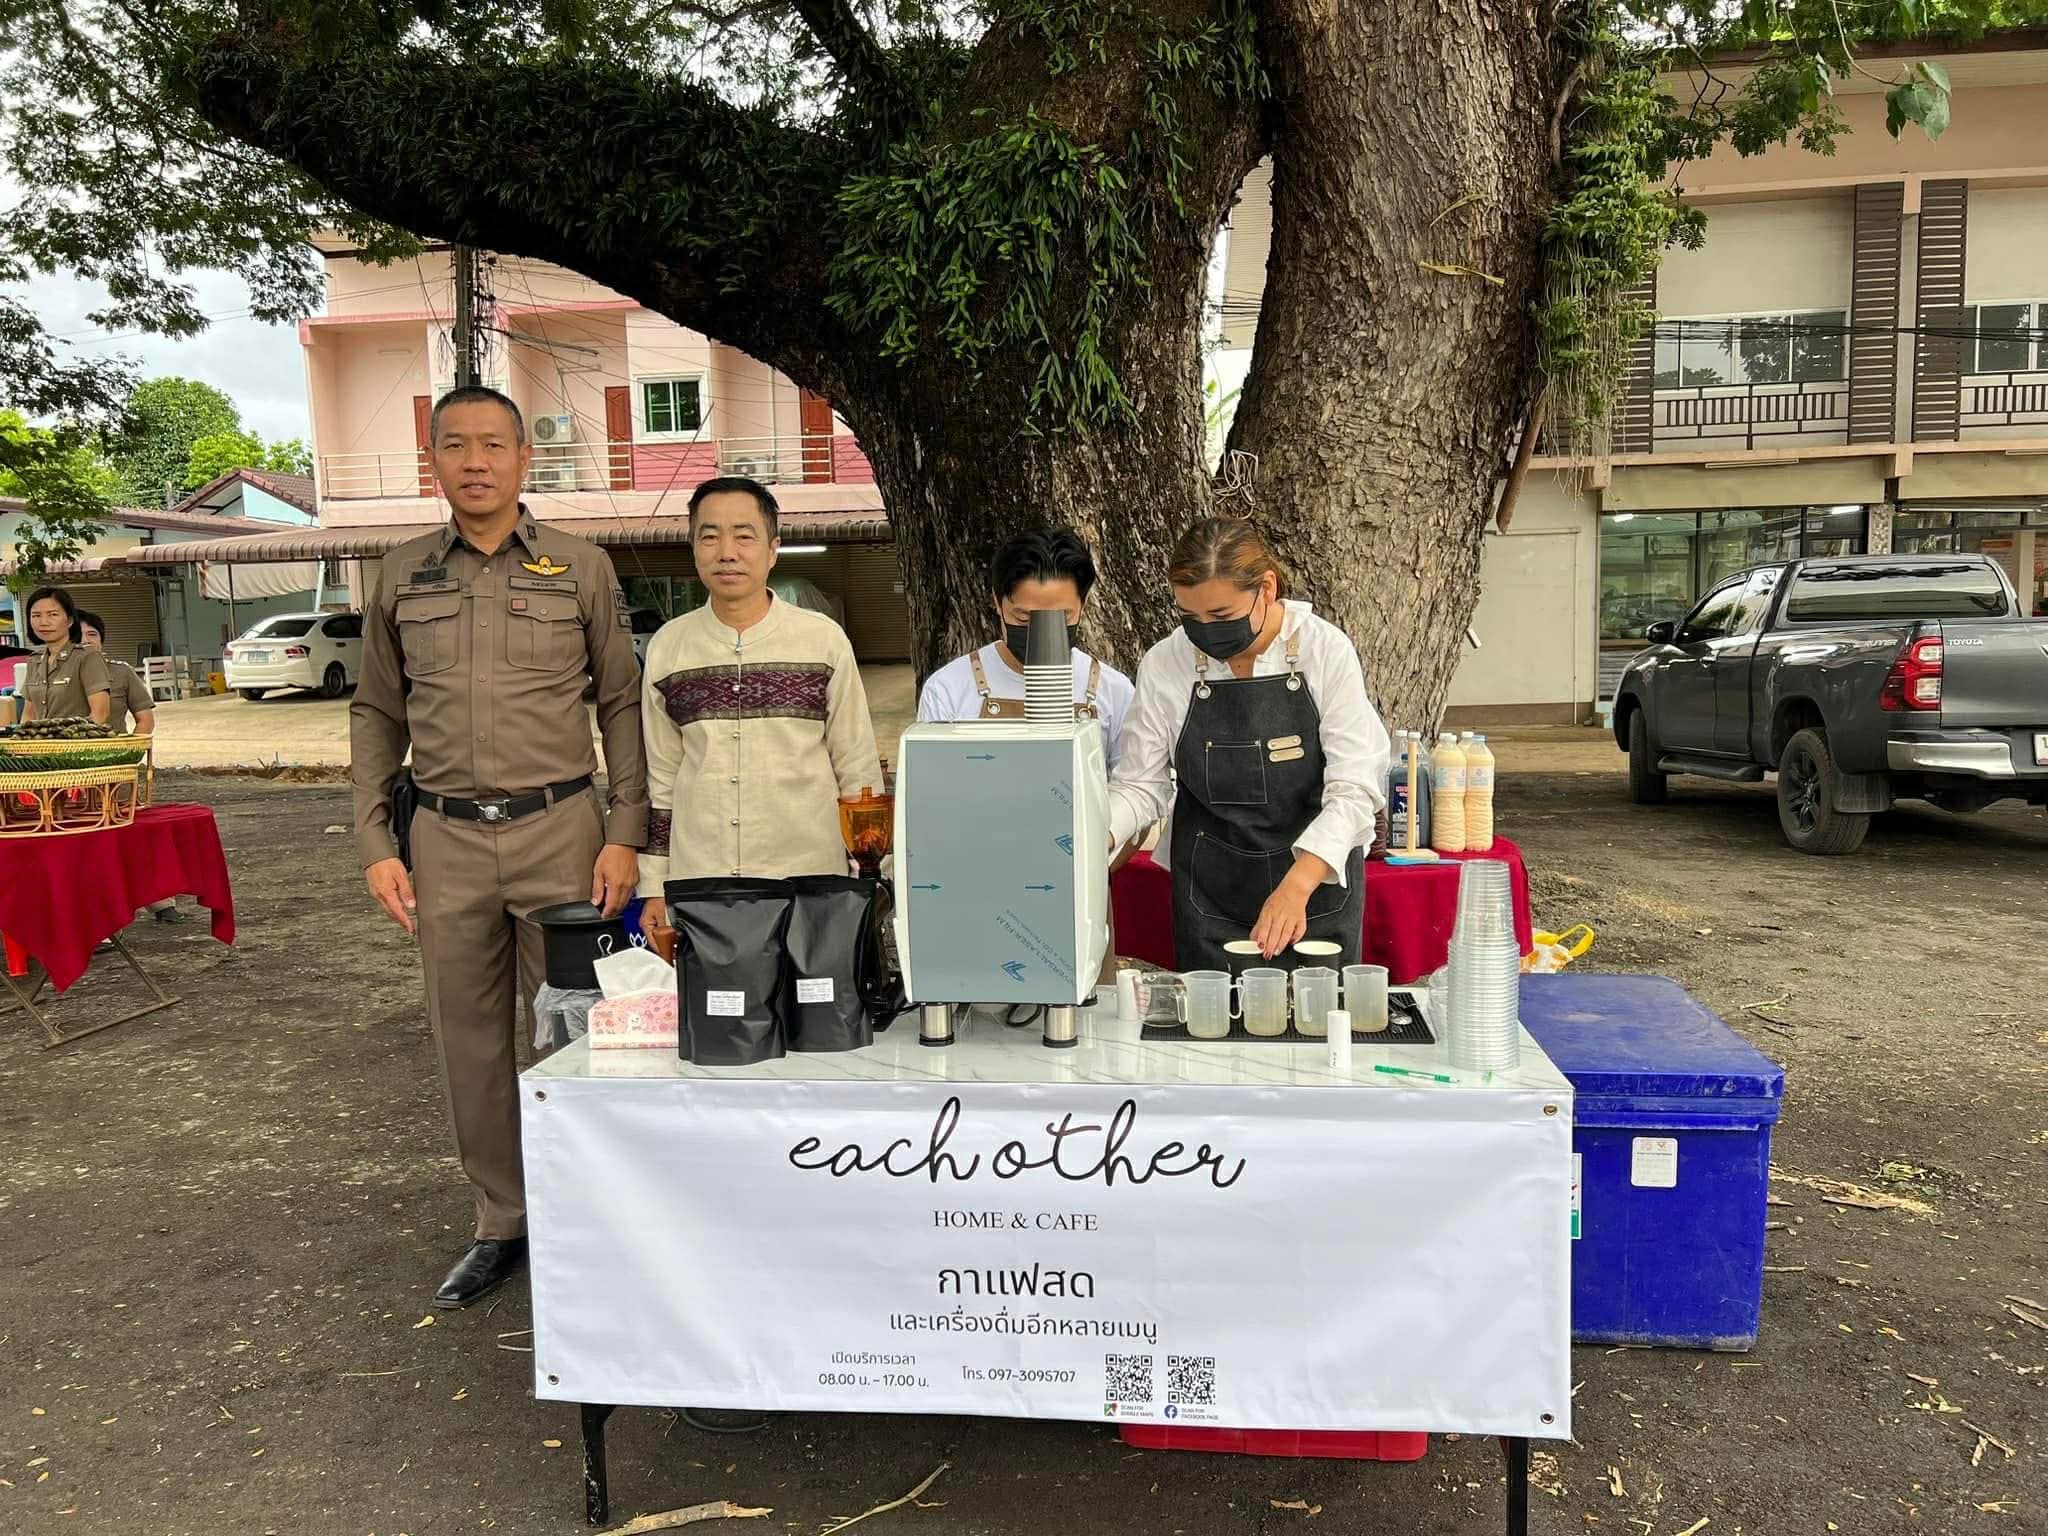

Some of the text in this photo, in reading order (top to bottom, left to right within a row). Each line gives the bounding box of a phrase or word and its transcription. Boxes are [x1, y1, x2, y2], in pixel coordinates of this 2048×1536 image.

[1948, 638, 1984, 647] TOYOTA
[789, 1097, 1246, 1188] each other
[934, 1210, 1098, 1231] HOME & CAFE
[938, 1262, 1095, 1299] กาแฟสด
[890, 1304, 1157, 1345] และเครื่องดื่มอีกหลายเมนู
[831, 1351, 916, 1366] เปิดบริการเวลา
[818, 1373, 856, 1386] 08.00
[858, 1375, 871, 1386] น.
[883, 1374, 915, 1387] 17.00
[917, 1377, 930, 1388] น.
[961, 1365, 1076, 1383] โทร. 097-3095707
